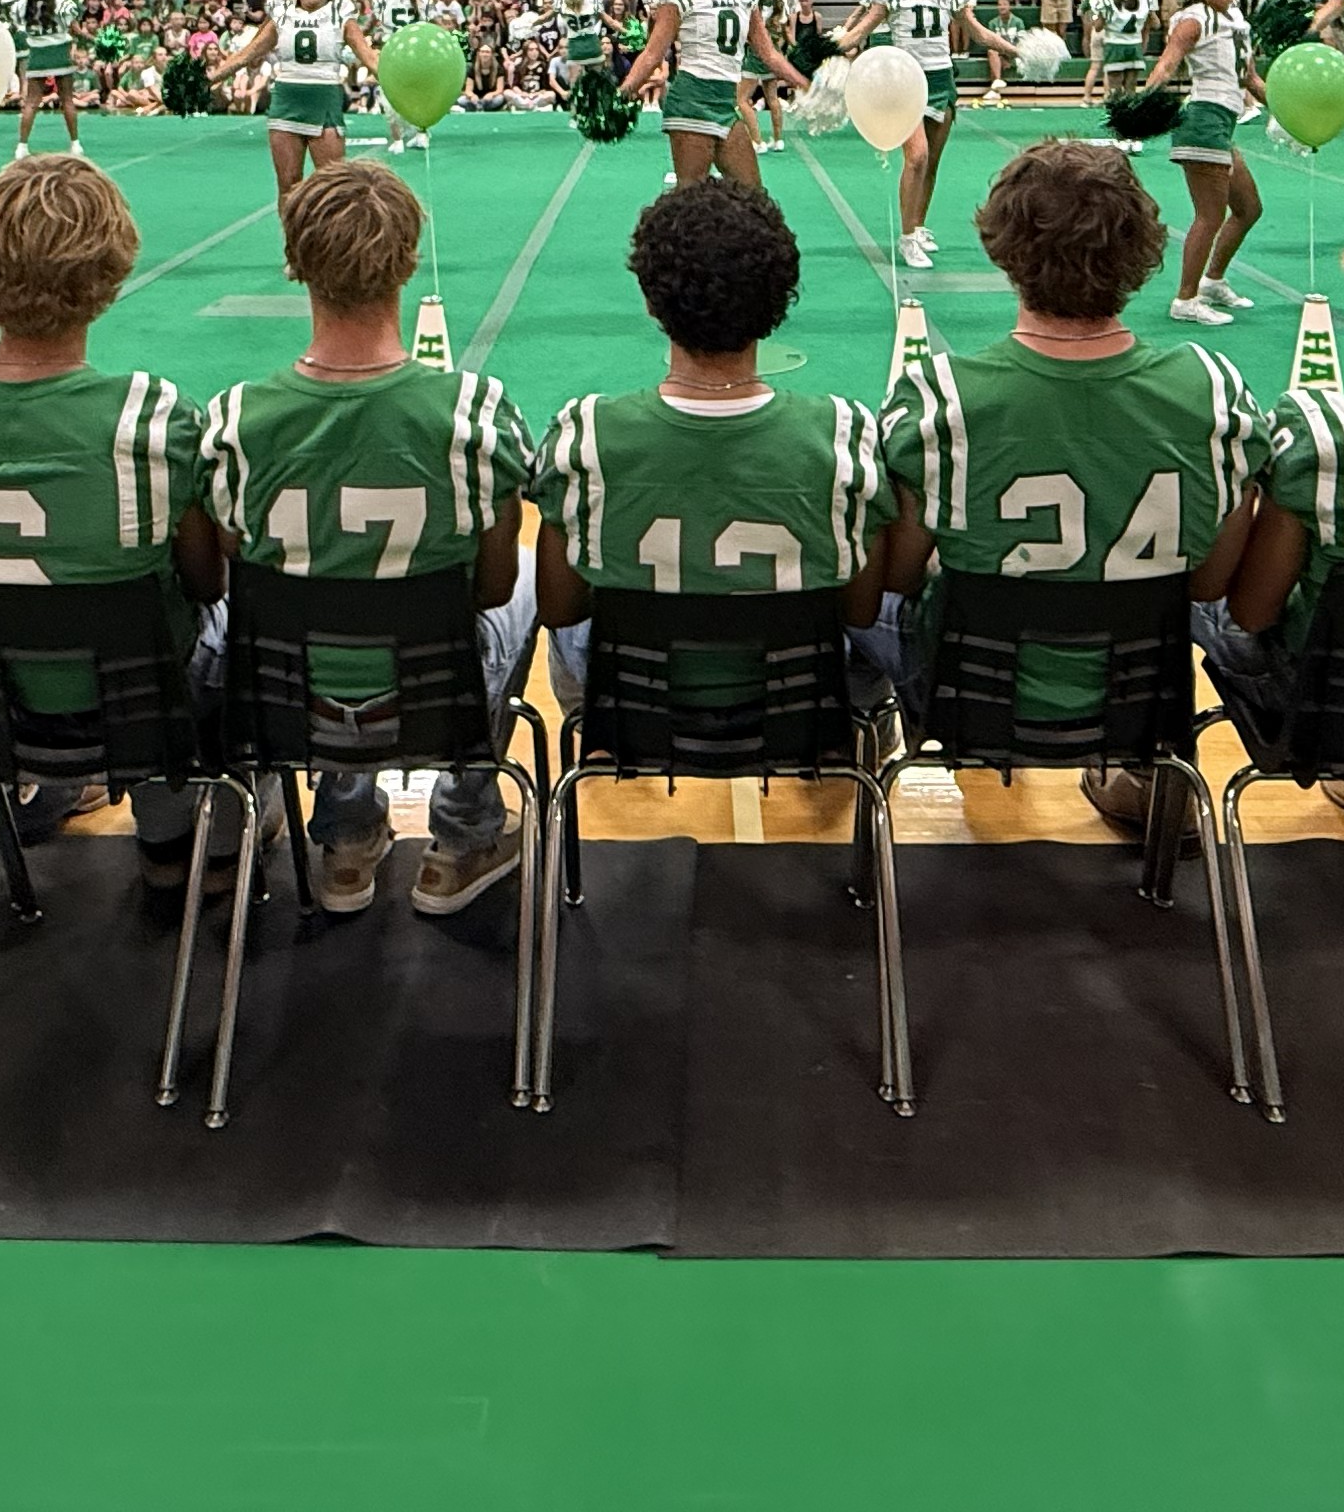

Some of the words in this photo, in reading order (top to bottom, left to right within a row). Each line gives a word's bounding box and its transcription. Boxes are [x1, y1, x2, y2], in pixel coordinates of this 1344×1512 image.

[717, 9, 741, 56] 0
[911, 4, 941, 37] 11
[1297, 330, 1339, 392] HA
[268, 485, 428, 579] 17
[999, 472, 1189, 582] 24
